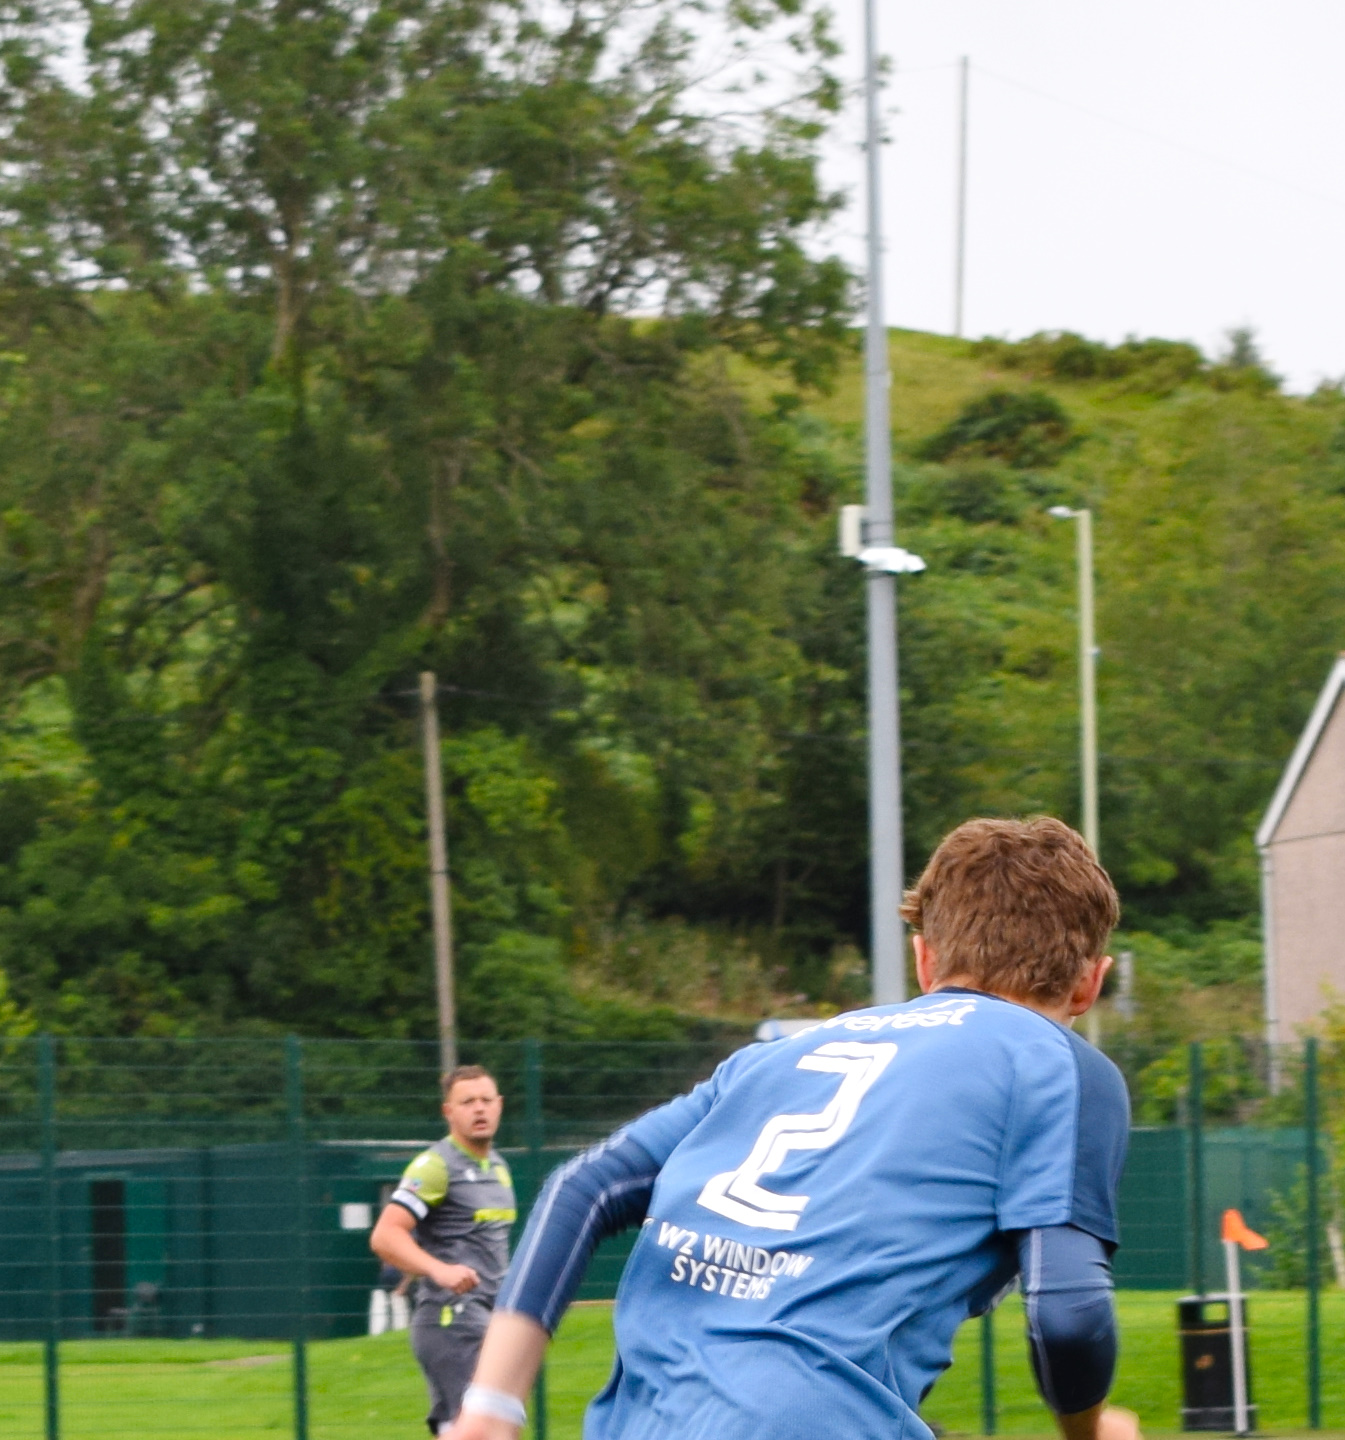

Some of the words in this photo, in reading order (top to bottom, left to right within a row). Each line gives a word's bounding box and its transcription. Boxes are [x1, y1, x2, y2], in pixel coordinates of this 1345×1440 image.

[696, 1041, 898, 1231] 2
[657, 1221, 699, 1256] W2
[703, 1234, 815, 1278] WINDOW
[670, 1255, 776, 1300] SYSTEMS
